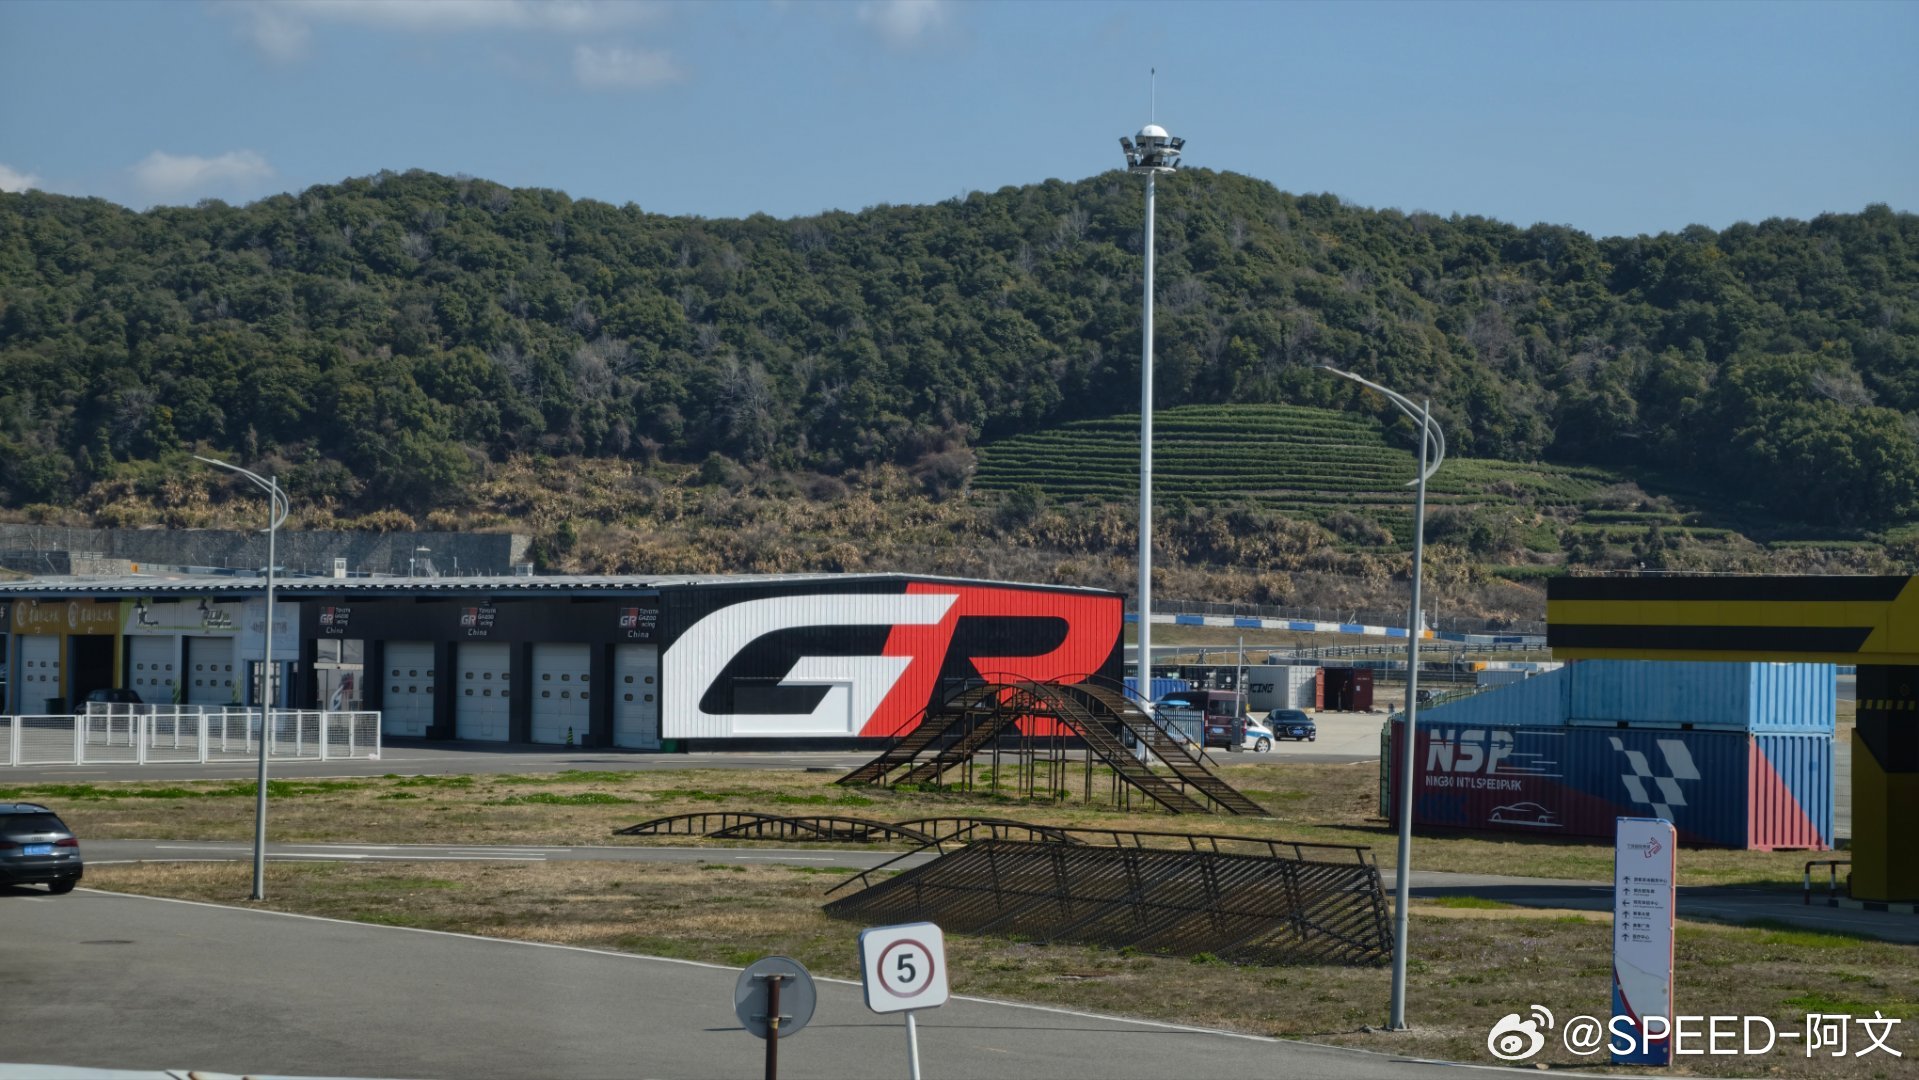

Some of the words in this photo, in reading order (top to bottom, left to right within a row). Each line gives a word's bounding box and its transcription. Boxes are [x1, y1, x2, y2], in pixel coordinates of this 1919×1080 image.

[461, 614, 476, 625] GR
[620, 616, 637, 626] GR
[662, 582, 1122, 738] GR
[1426, 728, 1514, 774] NSP
[897, 953, 916, 984] 5
